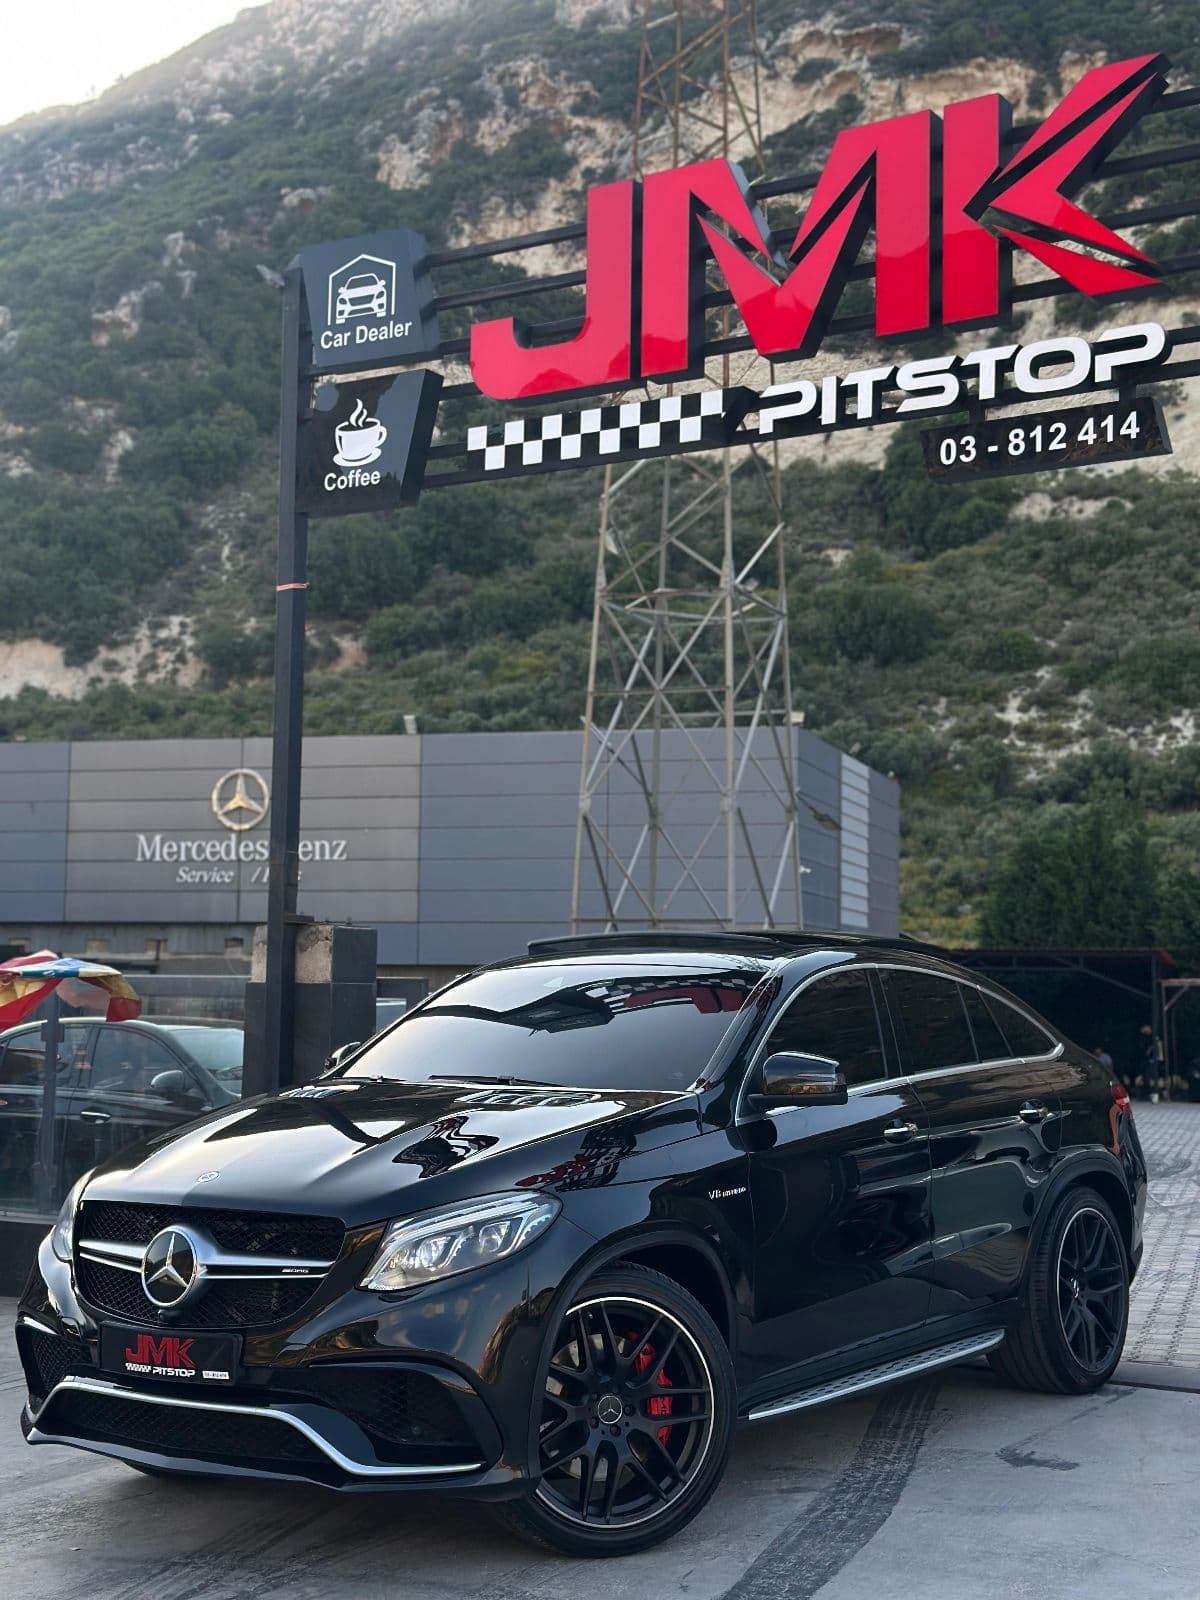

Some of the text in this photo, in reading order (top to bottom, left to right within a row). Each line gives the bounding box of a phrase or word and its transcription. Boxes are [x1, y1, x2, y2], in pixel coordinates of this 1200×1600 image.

[470, 51, 1167, 400] JMK
[320, 320, 413, 350] Car Dealer
[759, 321, 1167, 434] PITSTOP
[939, 410, 1140, 466] 03 - 812 414
[324, 468, 381, 491] Coffee
[136, 833, 348, 862] Mercedesenz
[176, 866, 234, 884] Service
[125, 1334, 197, 1368] JMK
[152, 1366, 196, 1377] PITSTOP
